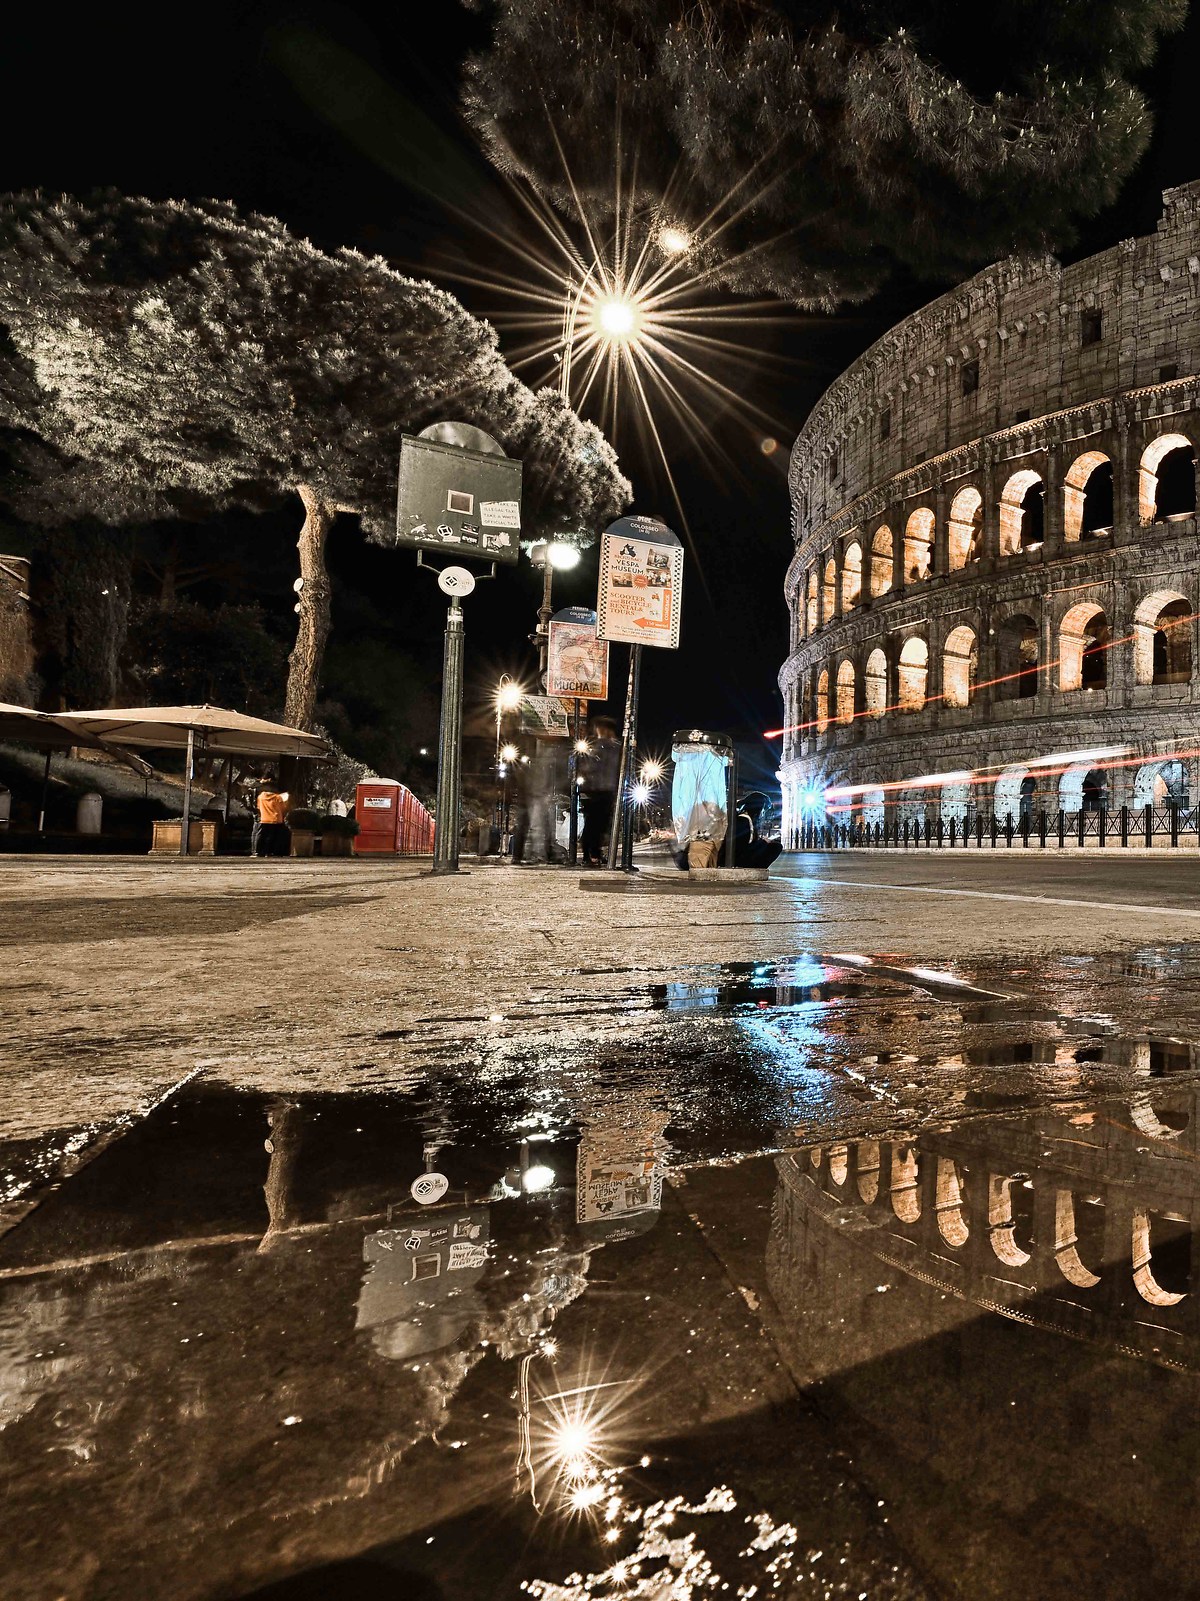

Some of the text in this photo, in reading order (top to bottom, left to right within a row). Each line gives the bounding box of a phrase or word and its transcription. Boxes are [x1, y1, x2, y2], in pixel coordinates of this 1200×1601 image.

[630, 522, 659, 532] COLOSSEO
[616, 559, 640, 568] VESPA
[611, 565, 644, 575] MUSEUM
[610, 592, 646, 602] SCOOTER
[620, 599, 653, 608] BICYCLE
[609, 608, 636, 616] TOURS
[554, 680, 590, 692] MUCHA
